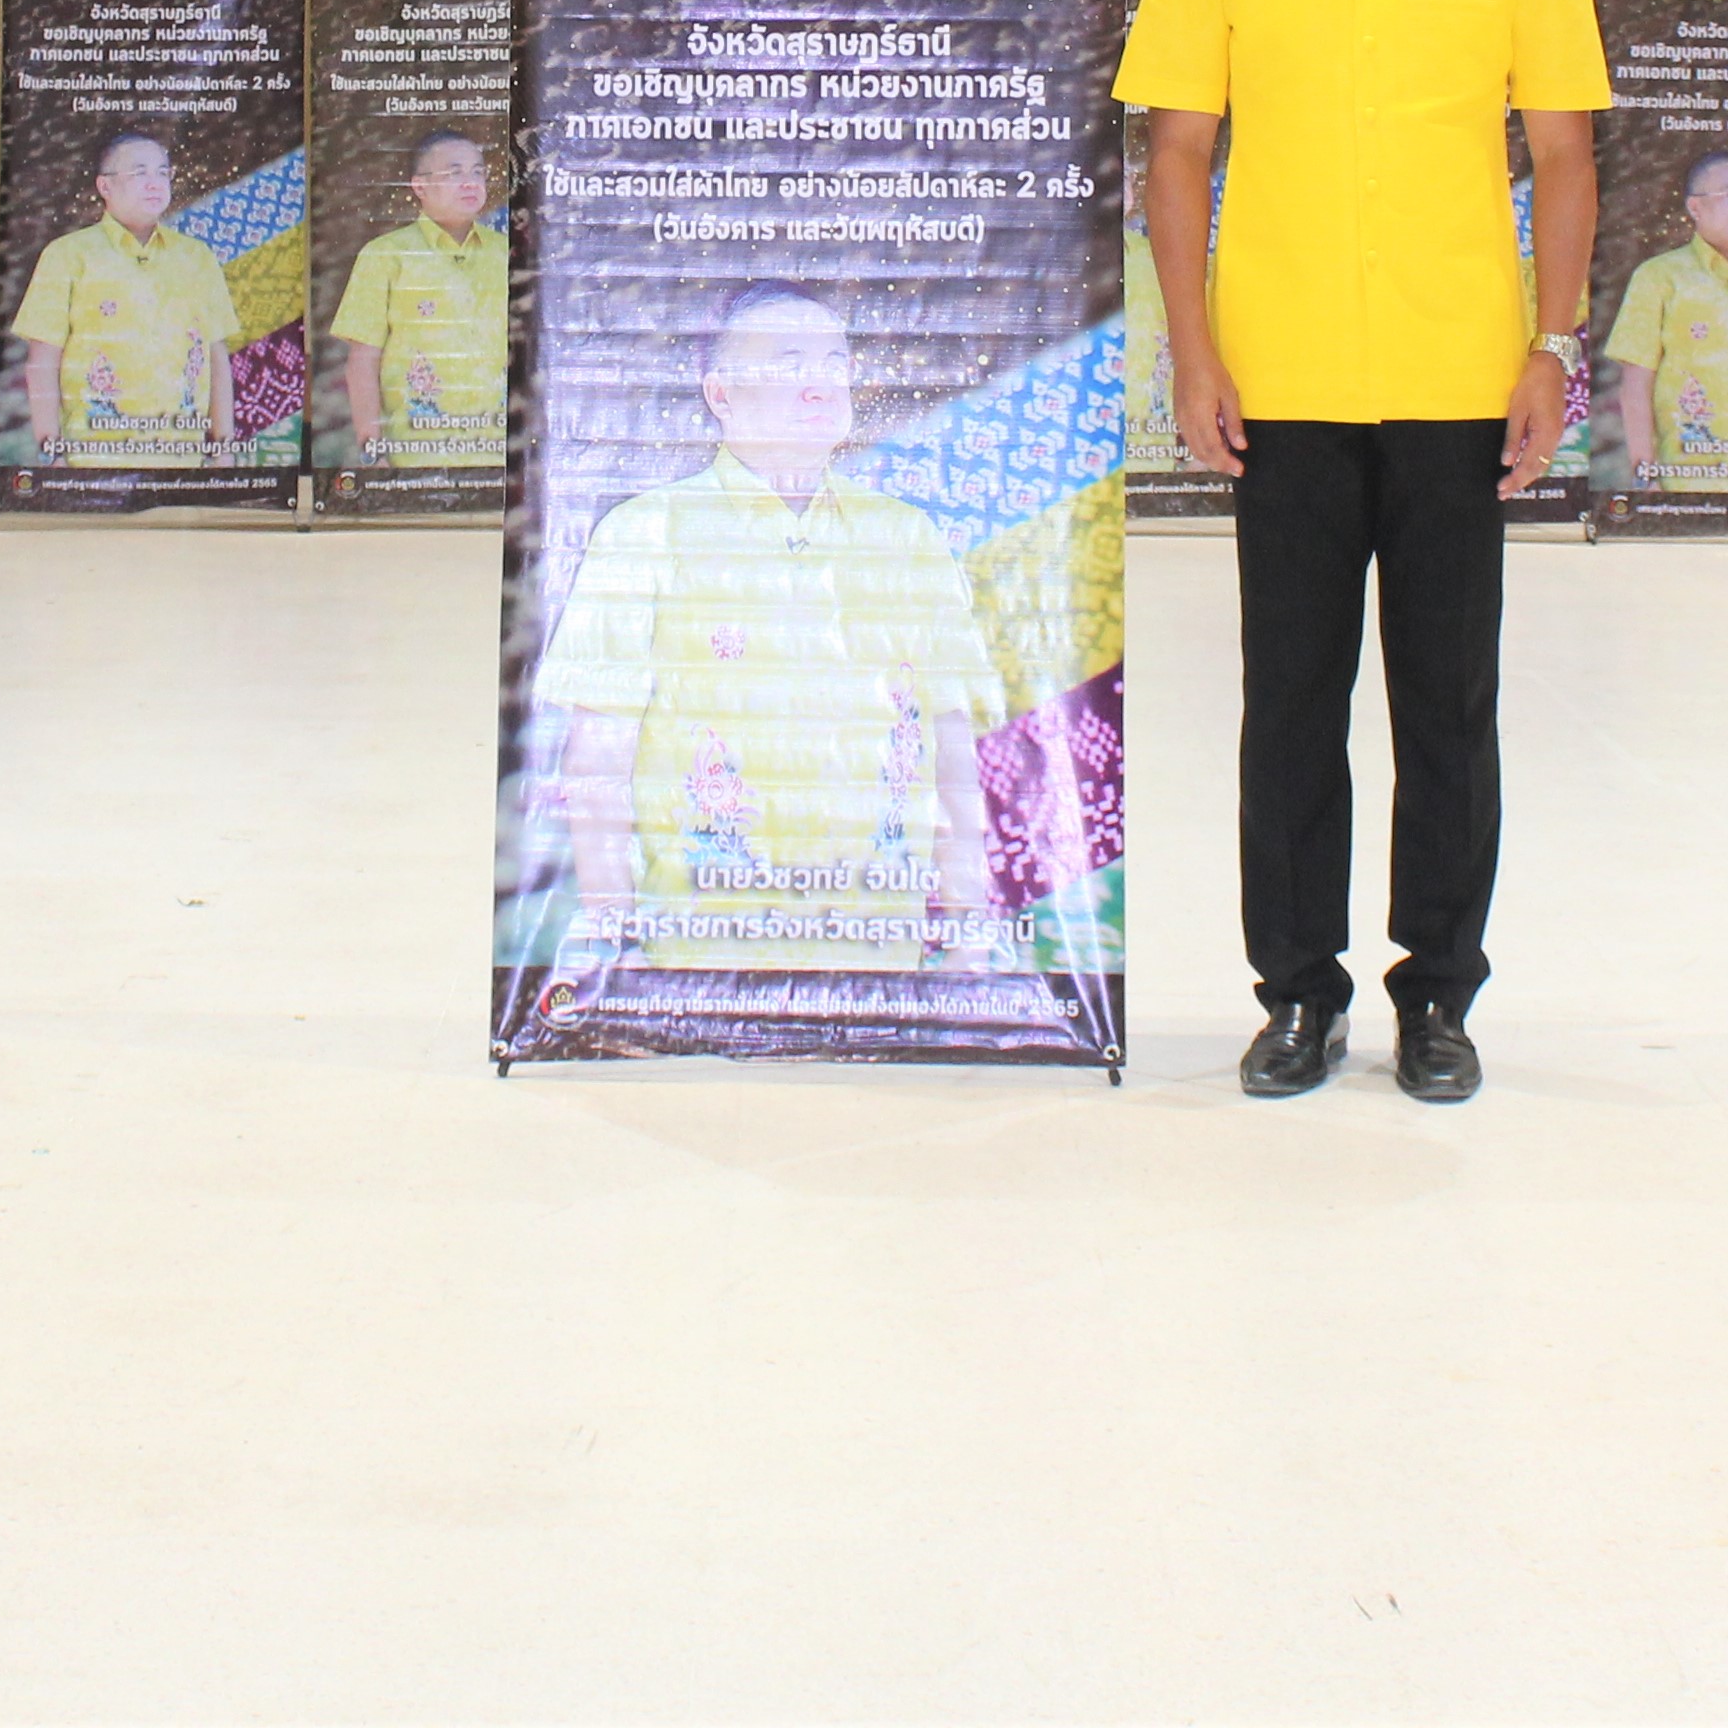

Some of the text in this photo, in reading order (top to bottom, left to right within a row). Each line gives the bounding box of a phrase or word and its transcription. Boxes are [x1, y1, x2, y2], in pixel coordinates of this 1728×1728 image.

[686, 22, 951, 65] จังหวัดสุราษฎร์ธานี
[593, 67, 1045, 108] ขอเชิญบุคลากร หน่วยงานภาครัฐ
[565, 109, 1070, 150] ภาคเอกชน และประชาชน ทุกภาคส่วน
[544, 165, 1095, 200] ใช้และสวมใส่ผ้าไทย อย่างน้อยสัปดาห์ละ 2 ครั้ง
[653, 215, 985, 249] (วันอังคาร และวันพฤหัสบดี)
[697, 857, 941, 897] นายวิชวุทย์ จินโต
[597, 911, 1035, 951] ผู้ว่าราชการจังหวัดสุราษฎร์ธานี
[1028, 997, 1079, 1018] 2565
